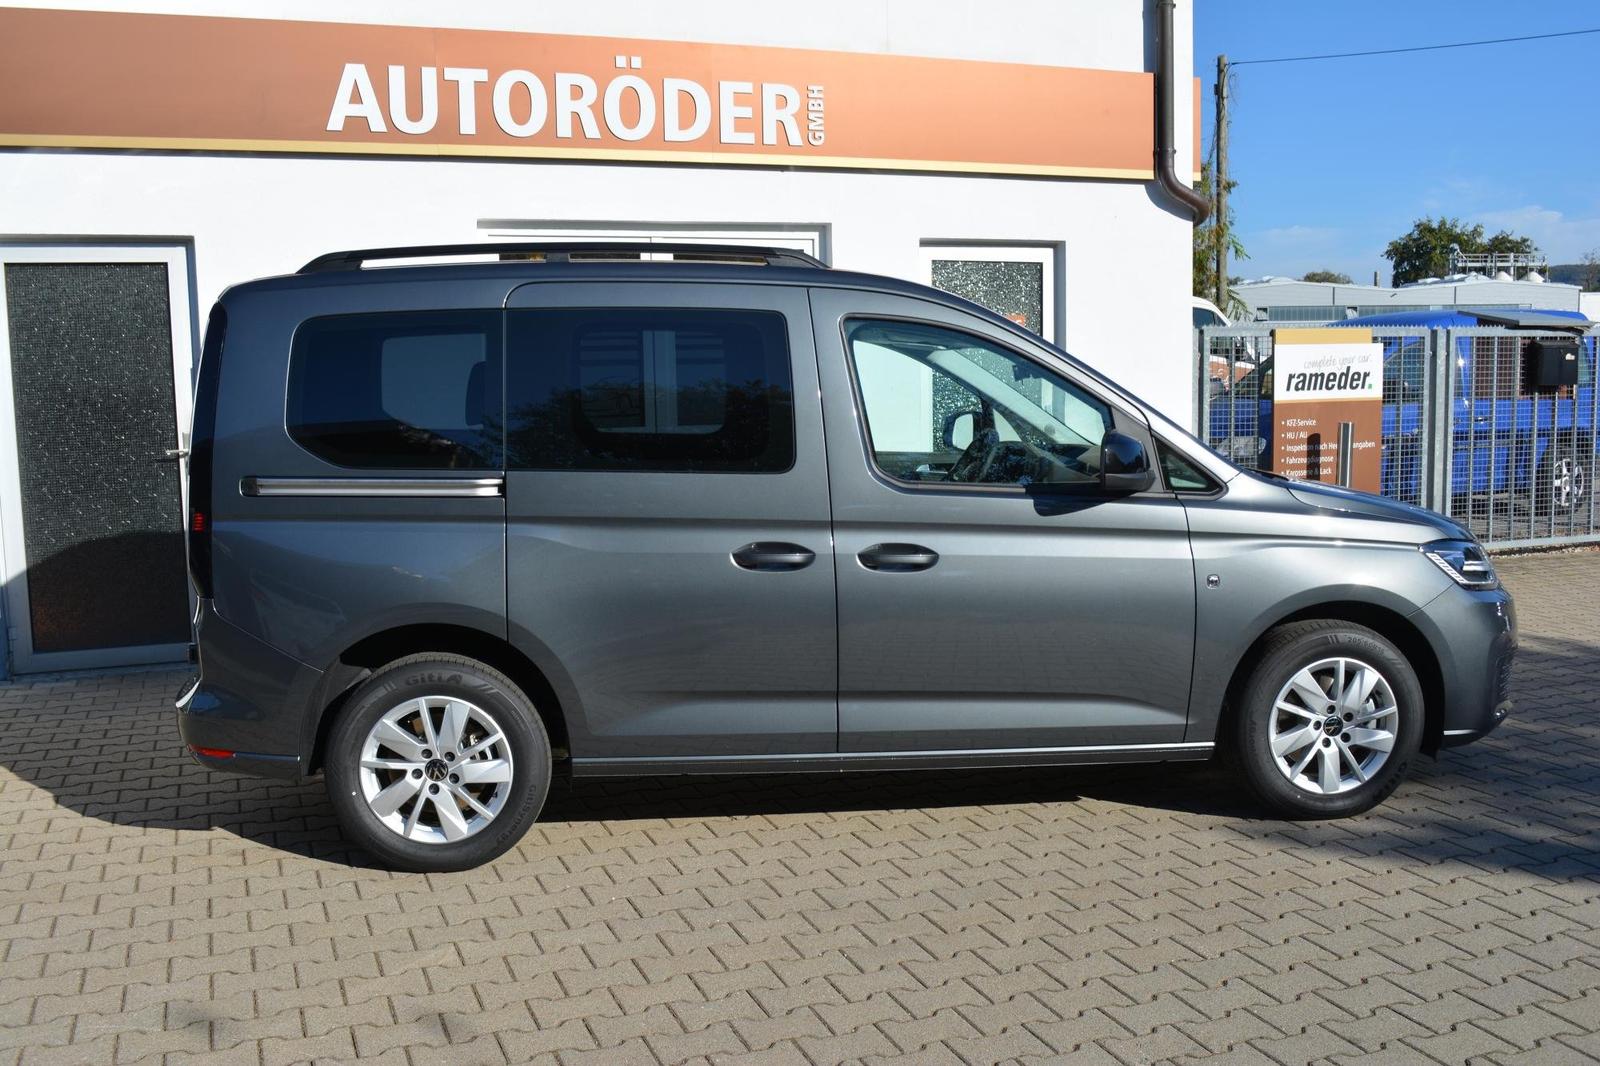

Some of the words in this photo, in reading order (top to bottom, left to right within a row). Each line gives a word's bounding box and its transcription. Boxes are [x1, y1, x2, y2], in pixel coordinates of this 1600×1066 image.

[326, 55, 804, 147] AUTORÖDER
[807, 84, 825, 147] GMBH
[1303, 355, 1337, 371] complete
[1338, 355, 1356, 371] your
[1286, 418, 1317, 427] KFZ-Service
[1286, 431, 1295, 439] HU
[1286, 443, 1314, 454] Inspektion
[1320, 466, 1332, 475] Lack
